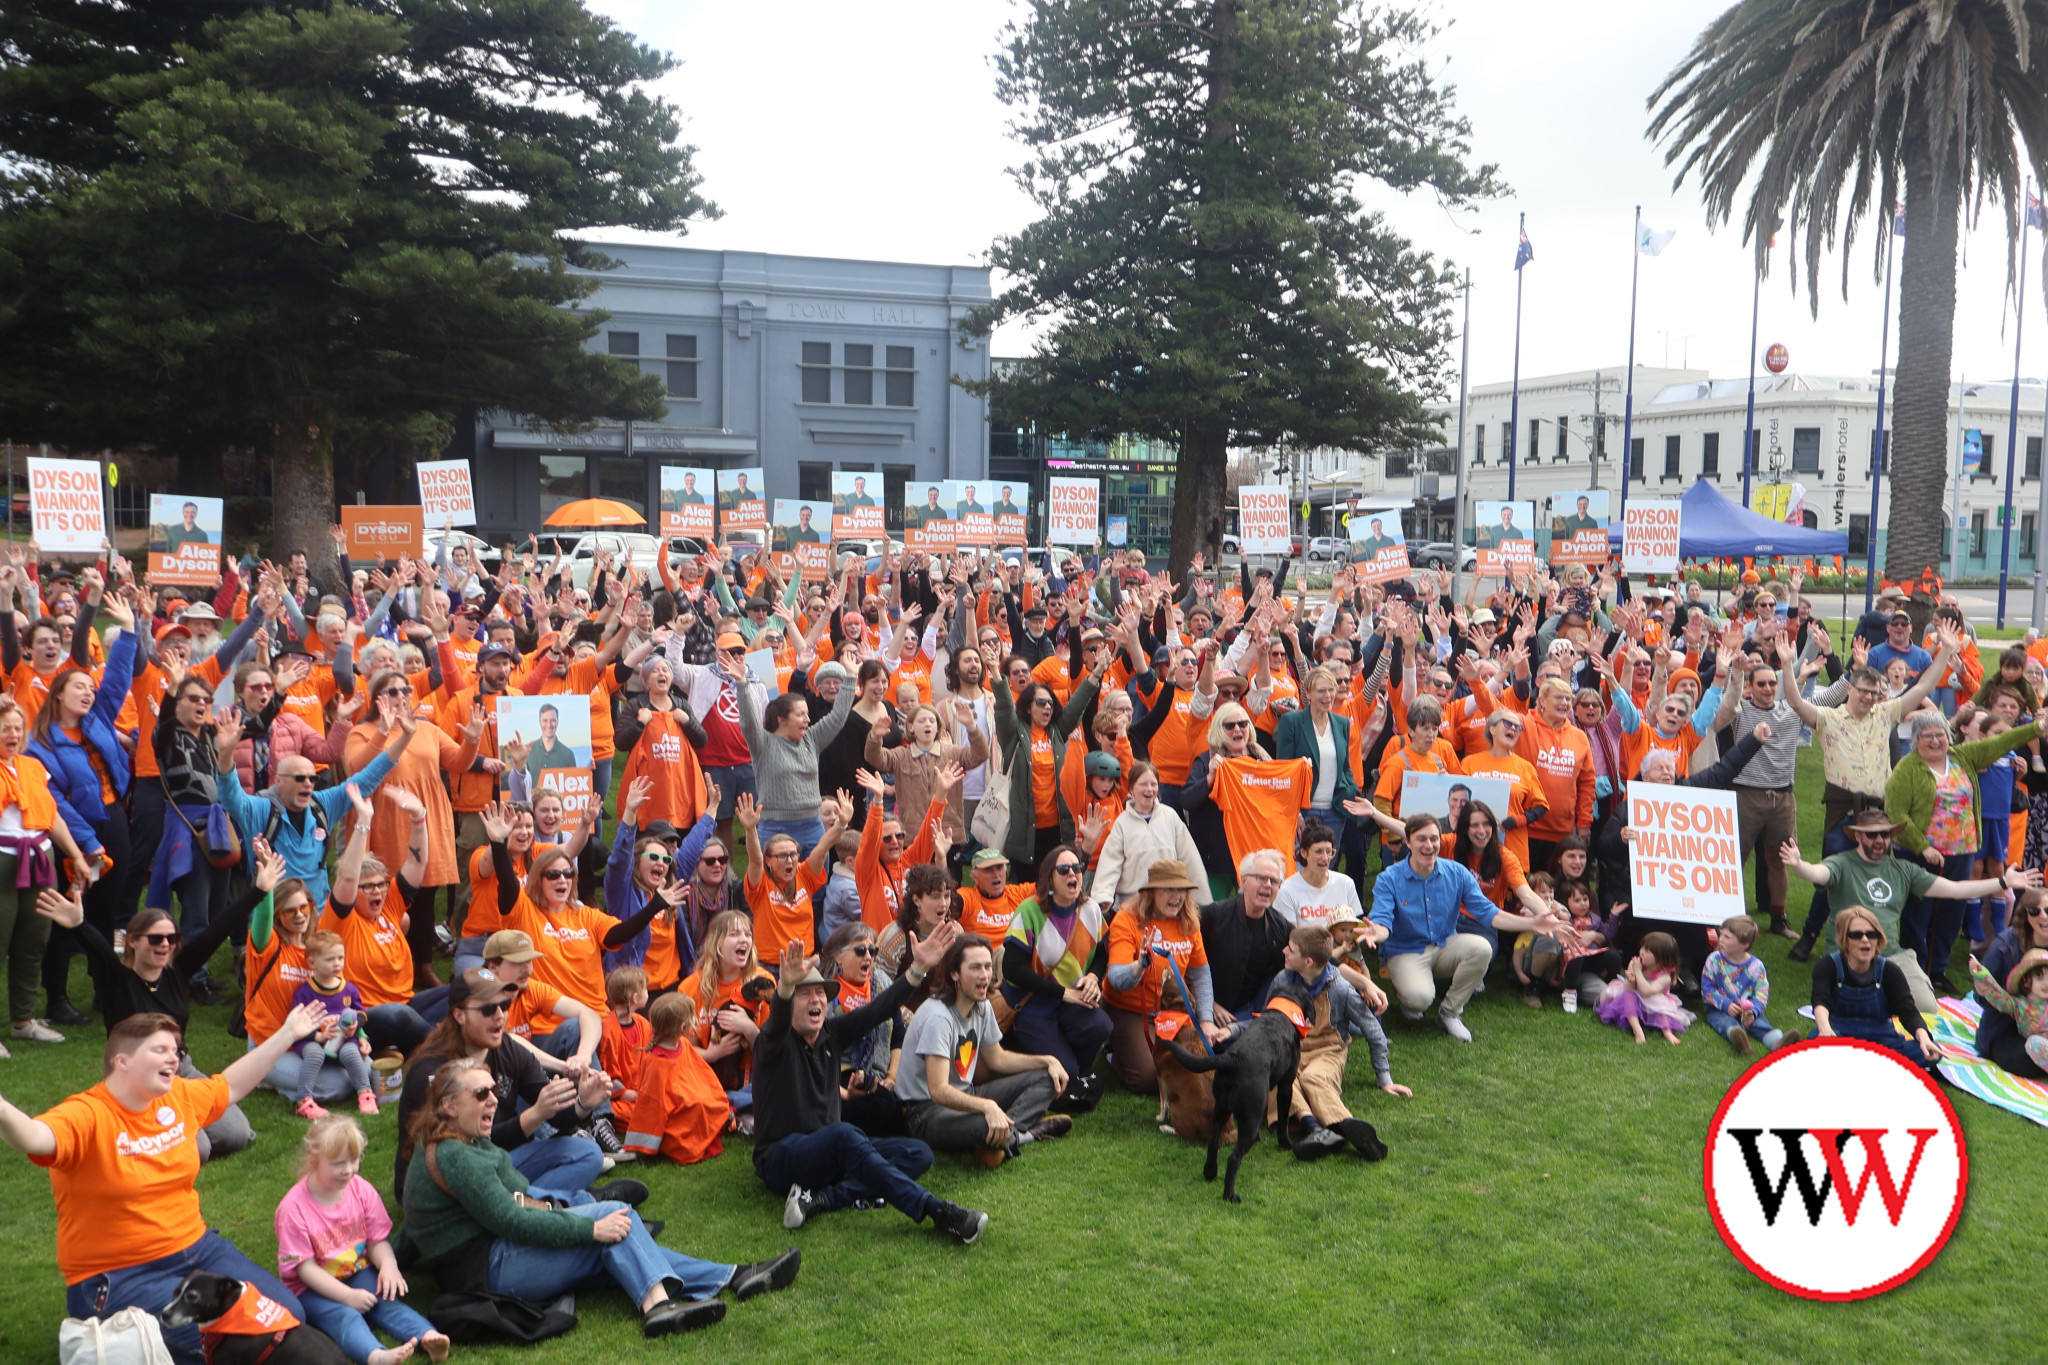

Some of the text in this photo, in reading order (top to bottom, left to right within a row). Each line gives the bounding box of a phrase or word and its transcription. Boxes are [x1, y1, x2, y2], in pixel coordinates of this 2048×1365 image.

[788, 303, 923, 324] TOWN HALL
[421, 468, 469, 485] DYSON
[1832, 417, 1848, 526] whalershotel
[33, 469, 99, 491] DYSON
[423, 484, 471, 499] WANNON
[1052, 485, 1097, 501] DYSON
[35, 492, 100, 511] WANNON
[425, 498, 472, 514] IT'S ON!
[739, 502, 764, 512] Alex
[1052, 501, 1097, 515] WANNON
[1241, 493, 1287, 509] DYSON
[684, 505, 712, 517] Alex
[729, 510, 765, 524] Dyson
[854, 507, 883, 519] Alex
[1242, 509, 1288, 523] WANNON
[1626, 508, 1678, 525] DYSON
[36, 512, 102, 532] IT'S ON!
[670, 513, 713, 527] Dyson
[843, 514, 884, 529] Dyson
[926, 521, 955, 532] Alex
[966, 514, 992, 525] Alex
[1000, 515, 1024, 526] Alex
[1051, 515, 1073, 529] IT'S
[1075, 517, 1097, 530] ON!
[358, 526, 408, 534] DYSON
[956, 523, 993, 535] Dyson
[1242, 523, 1289, 539] IT'S ON!
[1626, 526, 1677, 540] WANNON
[914, 531, 955, 543] Dyson
[1575, 531, 1605, 543] Alex
[180, 545, 218, 560] Alex
[1377, 548, 1405, 561] Alex
[1501, 541, 1531, 553] Alex
[1562, 541, 1606, 555] Dyson
[1624, 541, 1677, 557] IT'S ON!
[162, 556, 218, 574] Dyson
[781, 553, 827, 568] Don
[1366, 558, 1408, 574] Dyson
[1487, 551, 1533, 566] Dyson
[542, 773, 590, 793] Alex
[1492, 770, 1521, 781] Dyson
[1633, 798, 1734, 836] DYSON
[1634, 831, 1737, 866] WANNON
[1635, 860, 1739, 896] IT'S ON!
